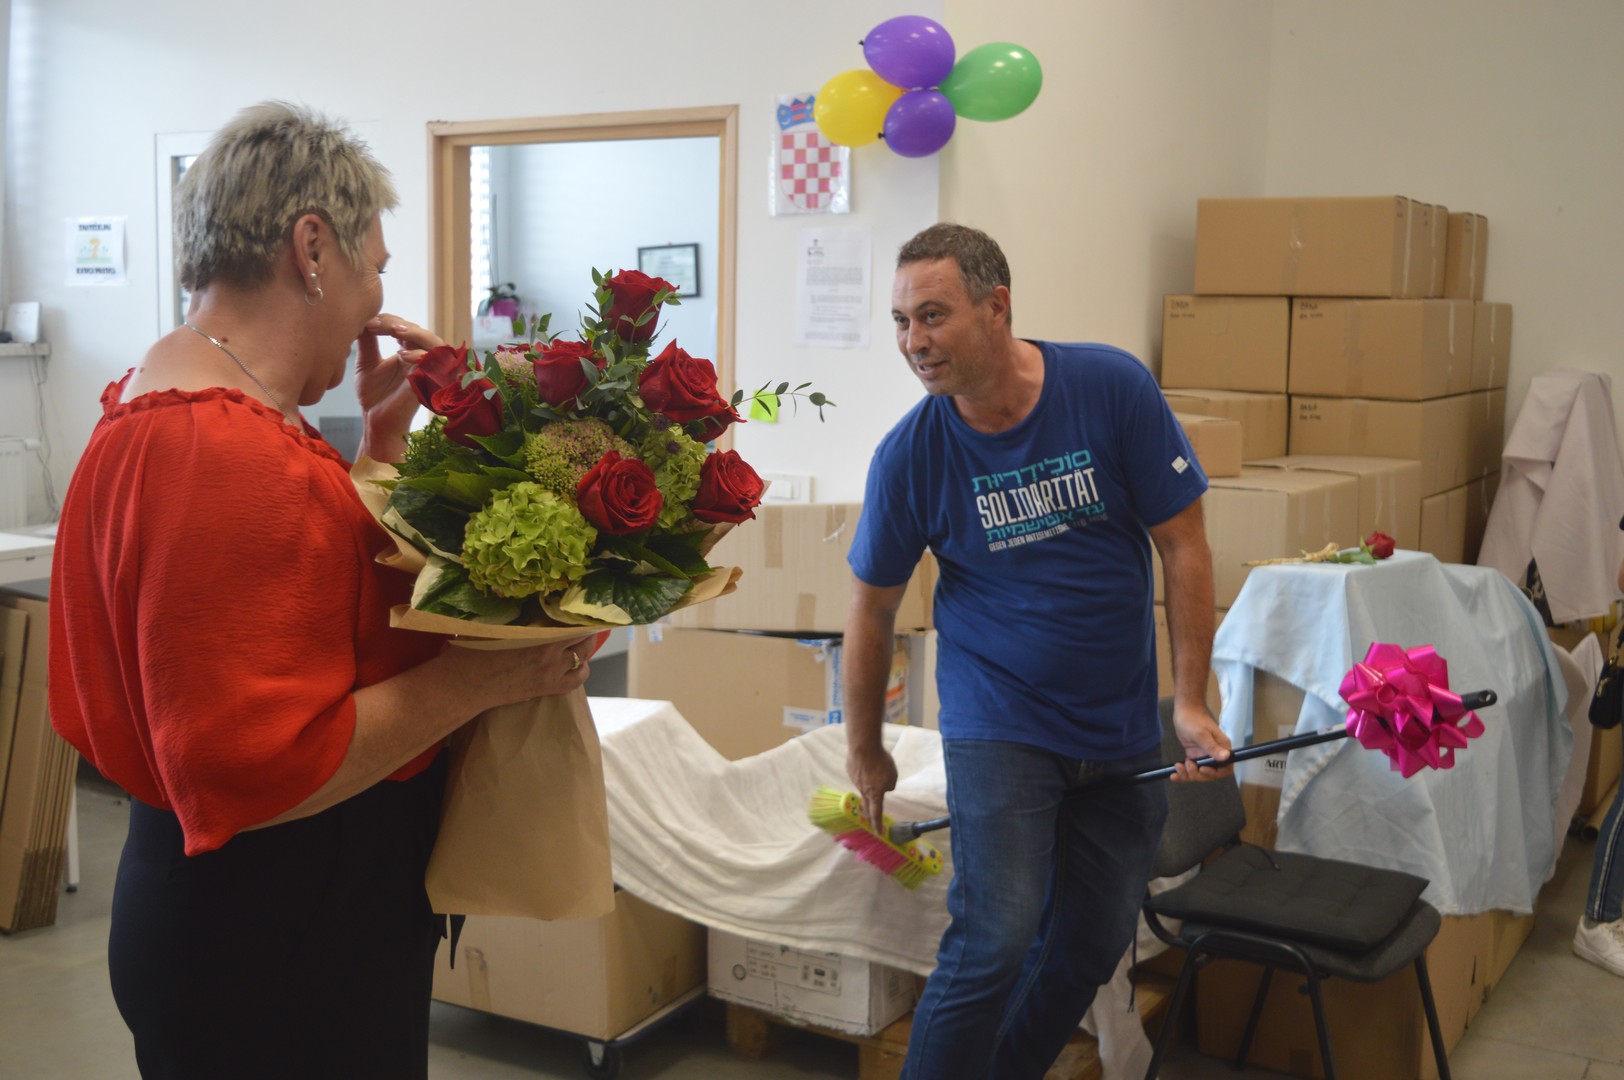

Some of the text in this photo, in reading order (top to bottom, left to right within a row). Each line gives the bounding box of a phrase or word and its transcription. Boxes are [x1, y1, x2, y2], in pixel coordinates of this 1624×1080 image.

[976, 467, 1100, 529] SOLIDARITÄT
[988, 540, 1008, 552] GEGEN
[1007, 535, 1027, 549] JEDEN
